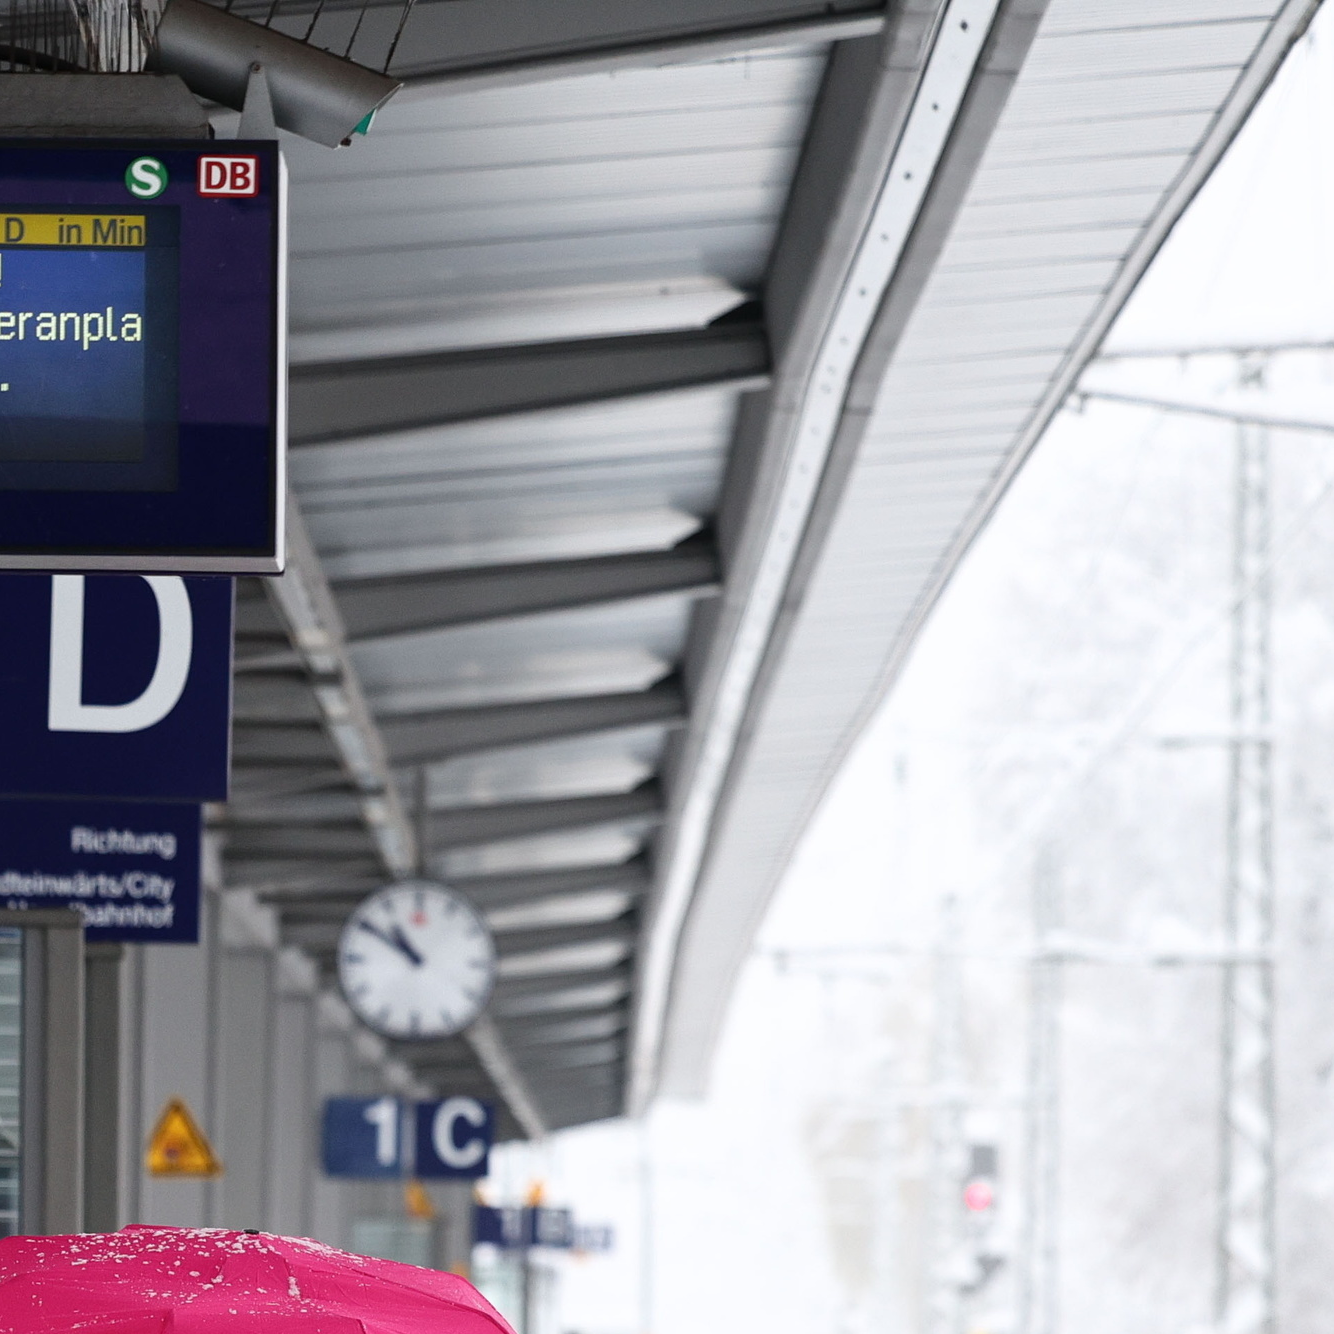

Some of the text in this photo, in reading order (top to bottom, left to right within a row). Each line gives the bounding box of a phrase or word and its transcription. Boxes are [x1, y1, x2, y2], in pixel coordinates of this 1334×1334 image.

[129, 158, 165, 199] S
[204, 161, 251, 194] DB
[4, 217, 25, 244] D
[57, 218, 144, 246] in Min
[48, 573, 193, 733] D
[70, 826, 177, 860] Richtung
[364, 1097, 487, 1169] 1 C
